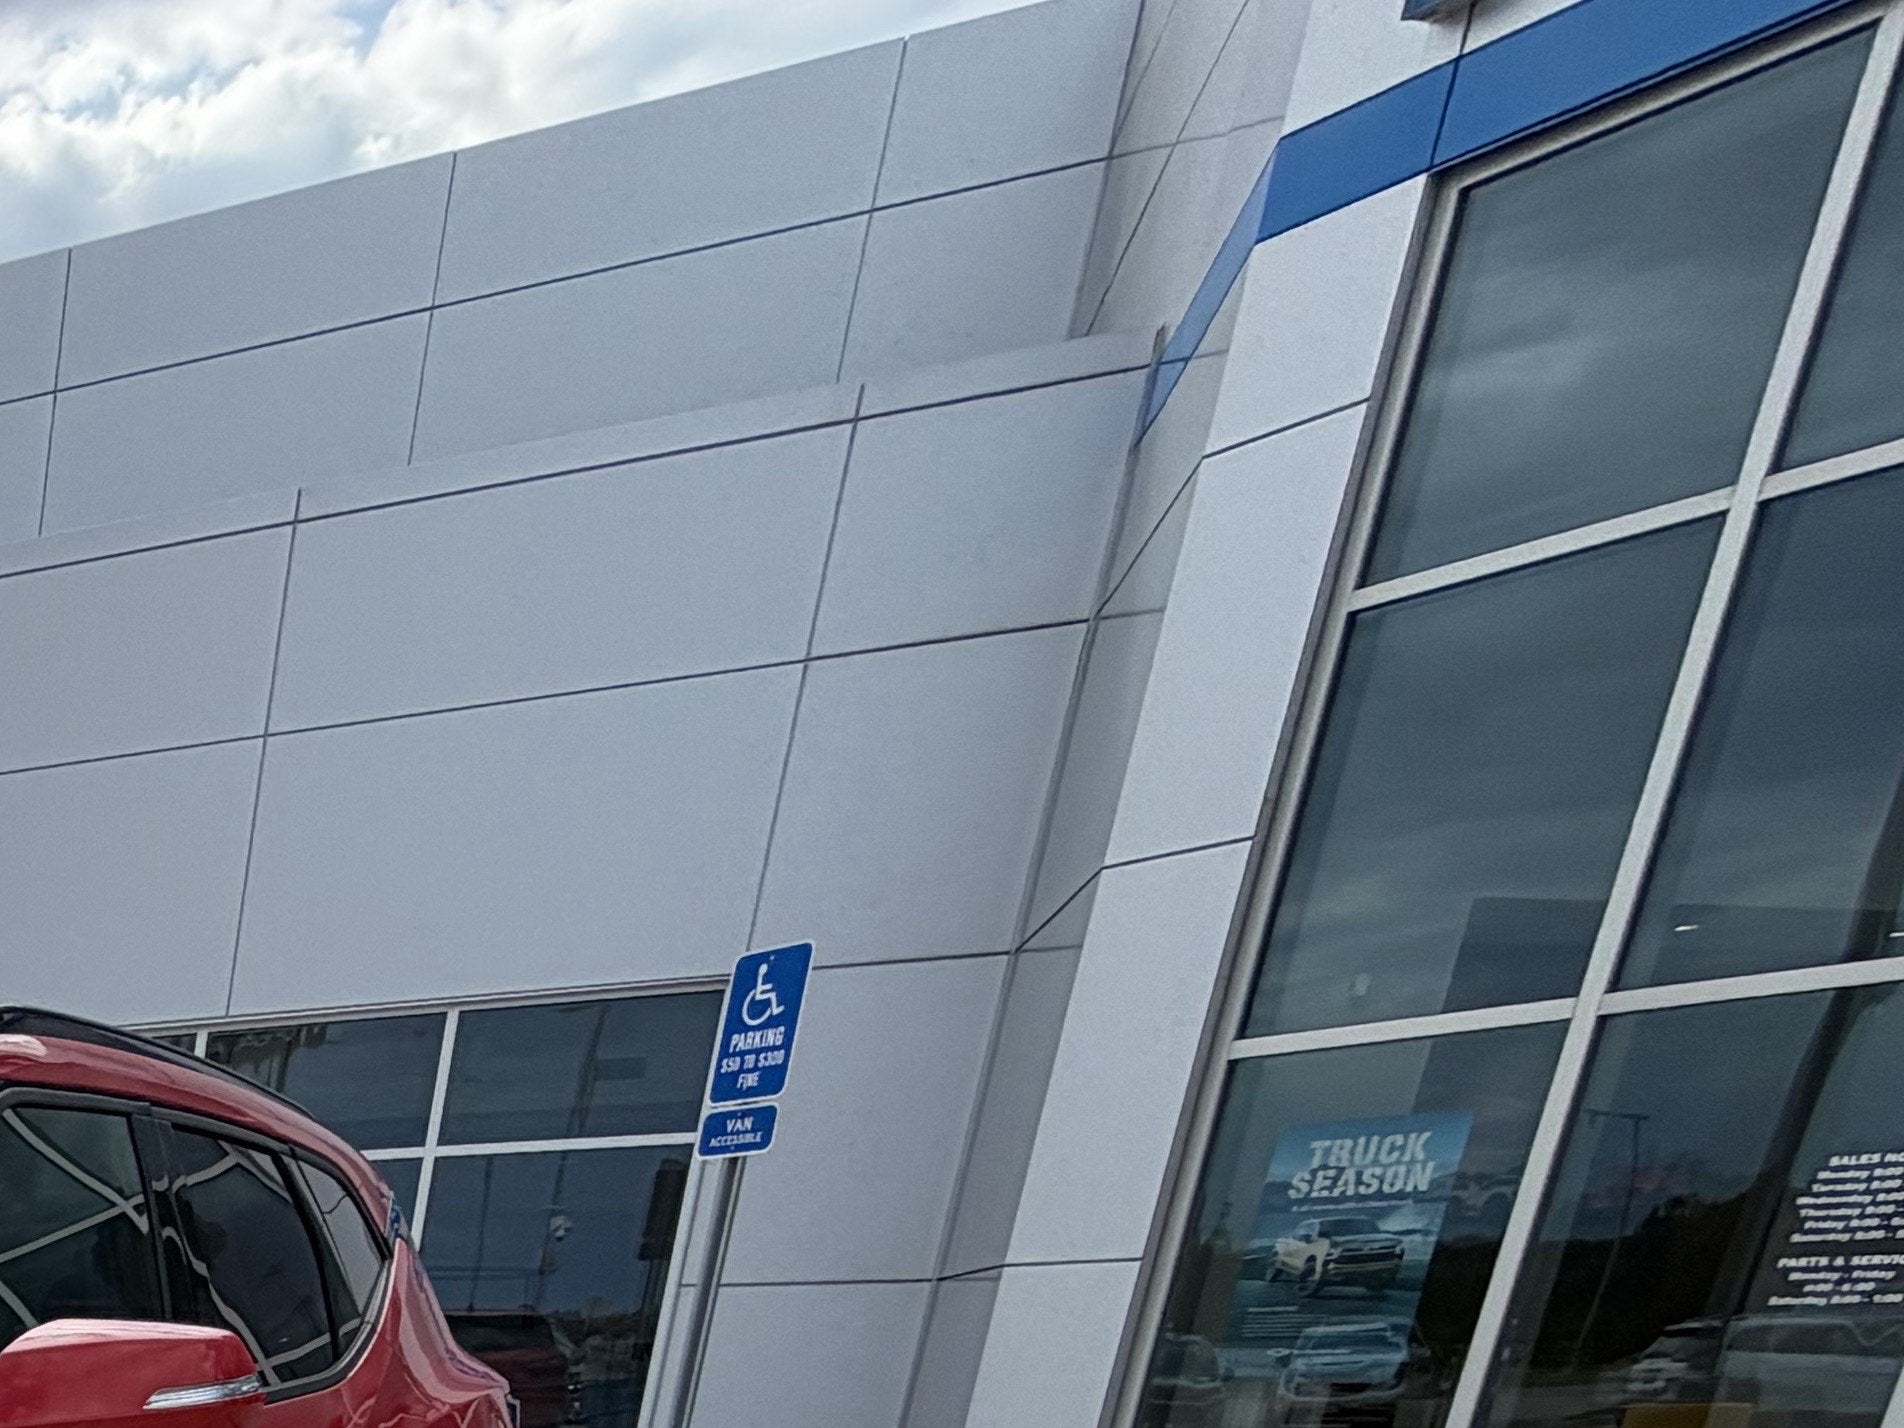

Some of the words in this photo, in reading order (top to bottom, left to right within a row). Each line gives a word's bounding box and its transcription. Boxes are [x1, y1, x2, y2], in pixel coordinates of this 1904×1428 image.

[729, 1026, 785, 1054] PARKING
[736, 1071, 760, 1091] FINE
[726, 1116, 754, 1133] VAN
[709, 1131, 763, 1147] ACCESSIBLE
[1309, 1131, 1433, 1168] TRUCK
[1288, 1161, 1435, 1199] SEASON
